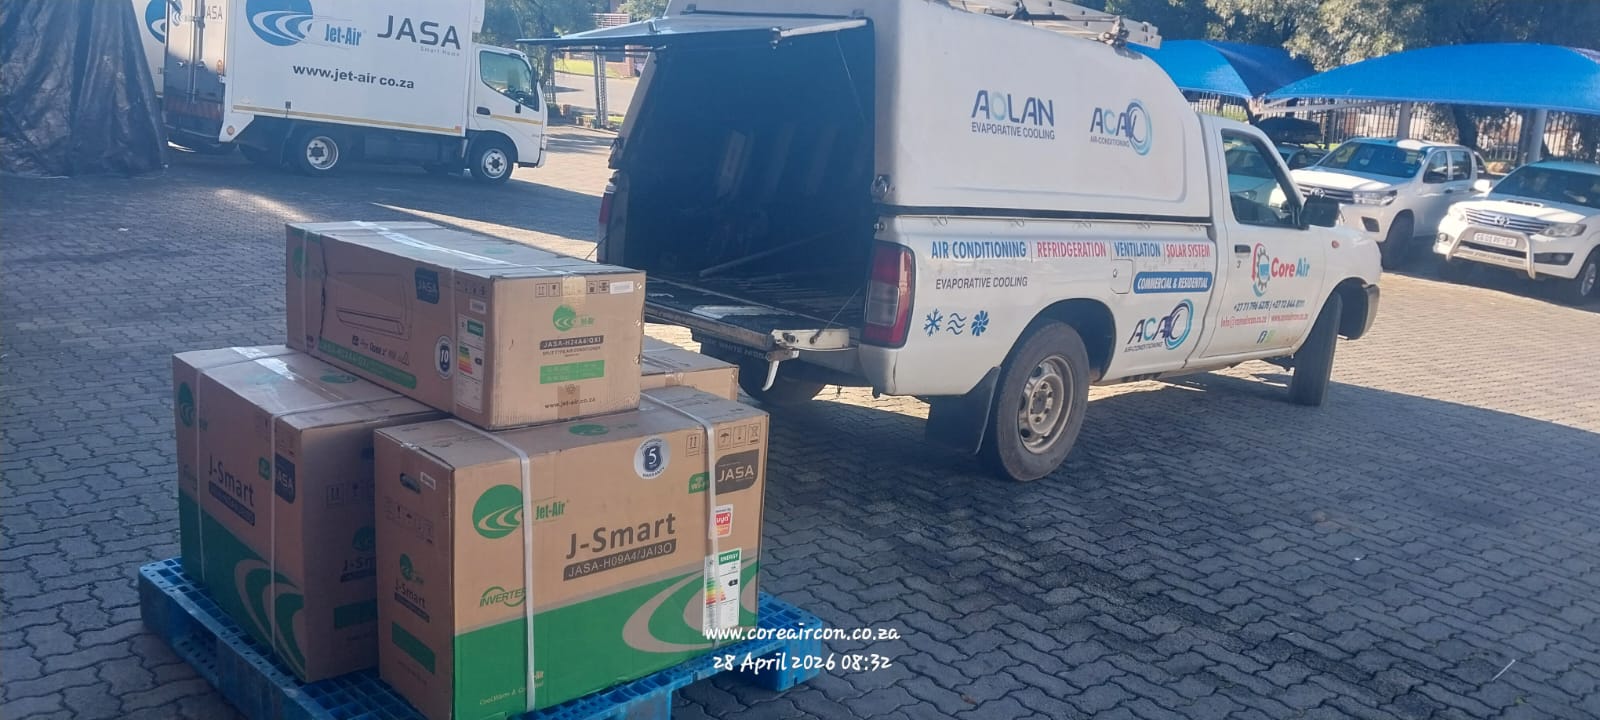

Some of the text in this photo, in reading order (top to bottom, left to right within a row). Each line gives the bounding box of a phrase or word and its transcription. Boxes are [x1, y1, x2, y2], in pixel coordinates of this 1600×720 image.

[324, 22, 362, 47] Jet-Air
[377, 15, 462, 51] JASA
[971, 89, 1055, 127] AOLAN
[971, 121, 1056, 140] EVAPORATIVE COOLING
[931, 241, 1211, 259] AIR CONDITIONING REFRIDGERATION VENTILATION SOLAR SYSTEM
[1271, 257, 1311, 278] Core Air
[935, 276, 1028, 290] EVAPORATIVE COOLING
[1137, 277, 1209, 290] COMMERCIAL & RESIDENTIAL
[648, 448, 657, 465] 5
[208, 455, 255, 507] J-Smart
[275, 468, 293, 493] ASA
[717, 465, 755, 483] JASA
[535, 500, 566, 522] Jet-Air
[565, 512, 677, 560] J-Smart
[394, 577, 426, 609] J-Smart
